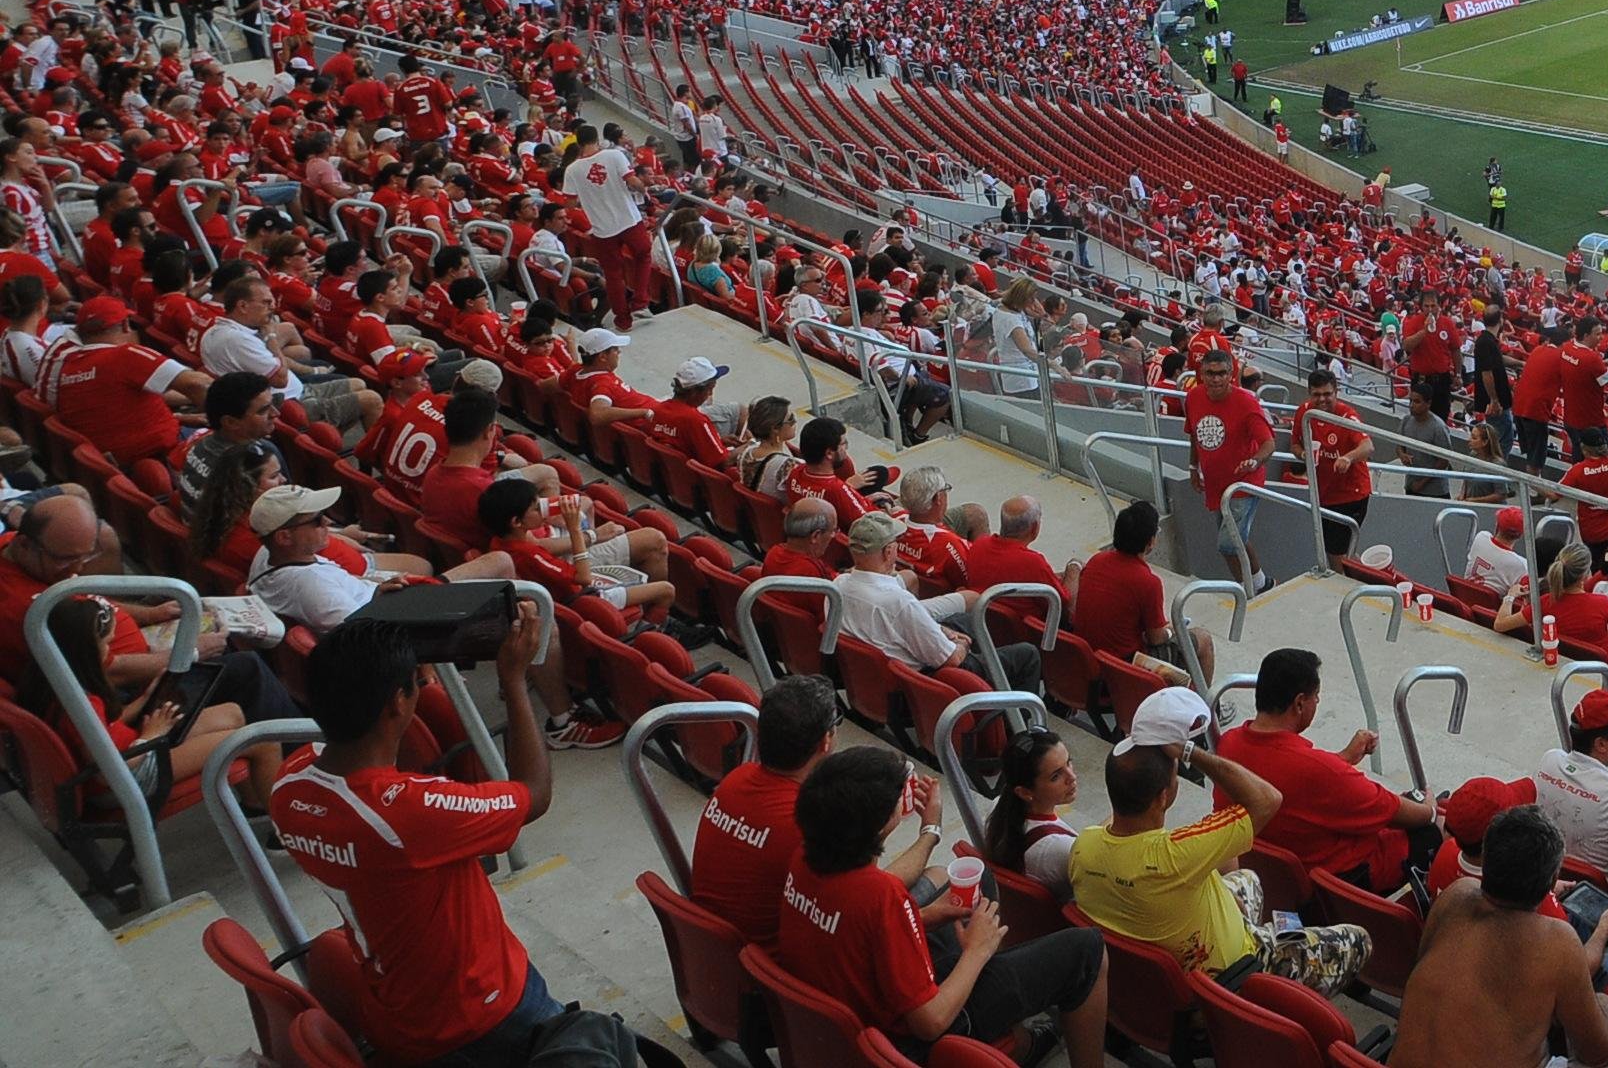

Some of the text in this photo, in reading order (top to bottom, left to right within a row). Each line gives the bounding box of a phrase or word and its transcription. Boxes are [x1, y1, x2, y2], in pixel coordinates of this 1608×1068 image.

[412, 95, 432, 116] 3
[388, 421, 437, 478] 10
[423, 790, 517, 814] TRAMONTINA
[704, 796, 771, 849] Banrisul
[783, 871, 842, 935] Banrisul
